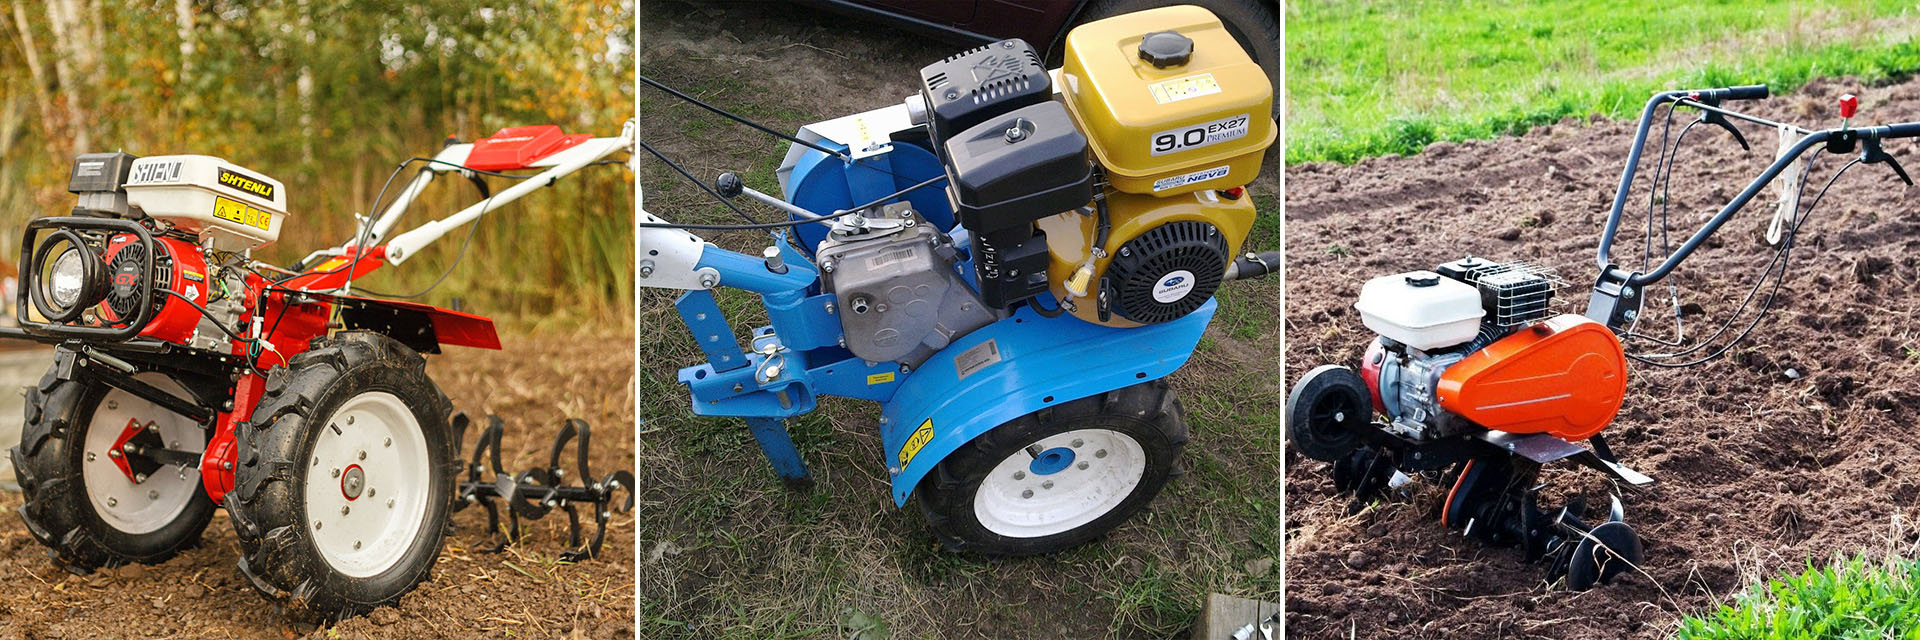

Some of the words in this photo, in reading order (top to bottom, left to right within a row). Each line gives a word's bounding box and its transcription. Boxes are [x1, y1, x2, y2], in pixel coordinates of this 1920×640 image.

[1155, 128, 1206, 152] 9.0
[1208, 117, 1246, 133] EX27
[1207, 128, 1246, 142] PREMIUM
[220, 171, 272, 197] SHTENLI
[115, 273, 139, 285] GX
[1158, 283, 1189, 294] SUBARU
